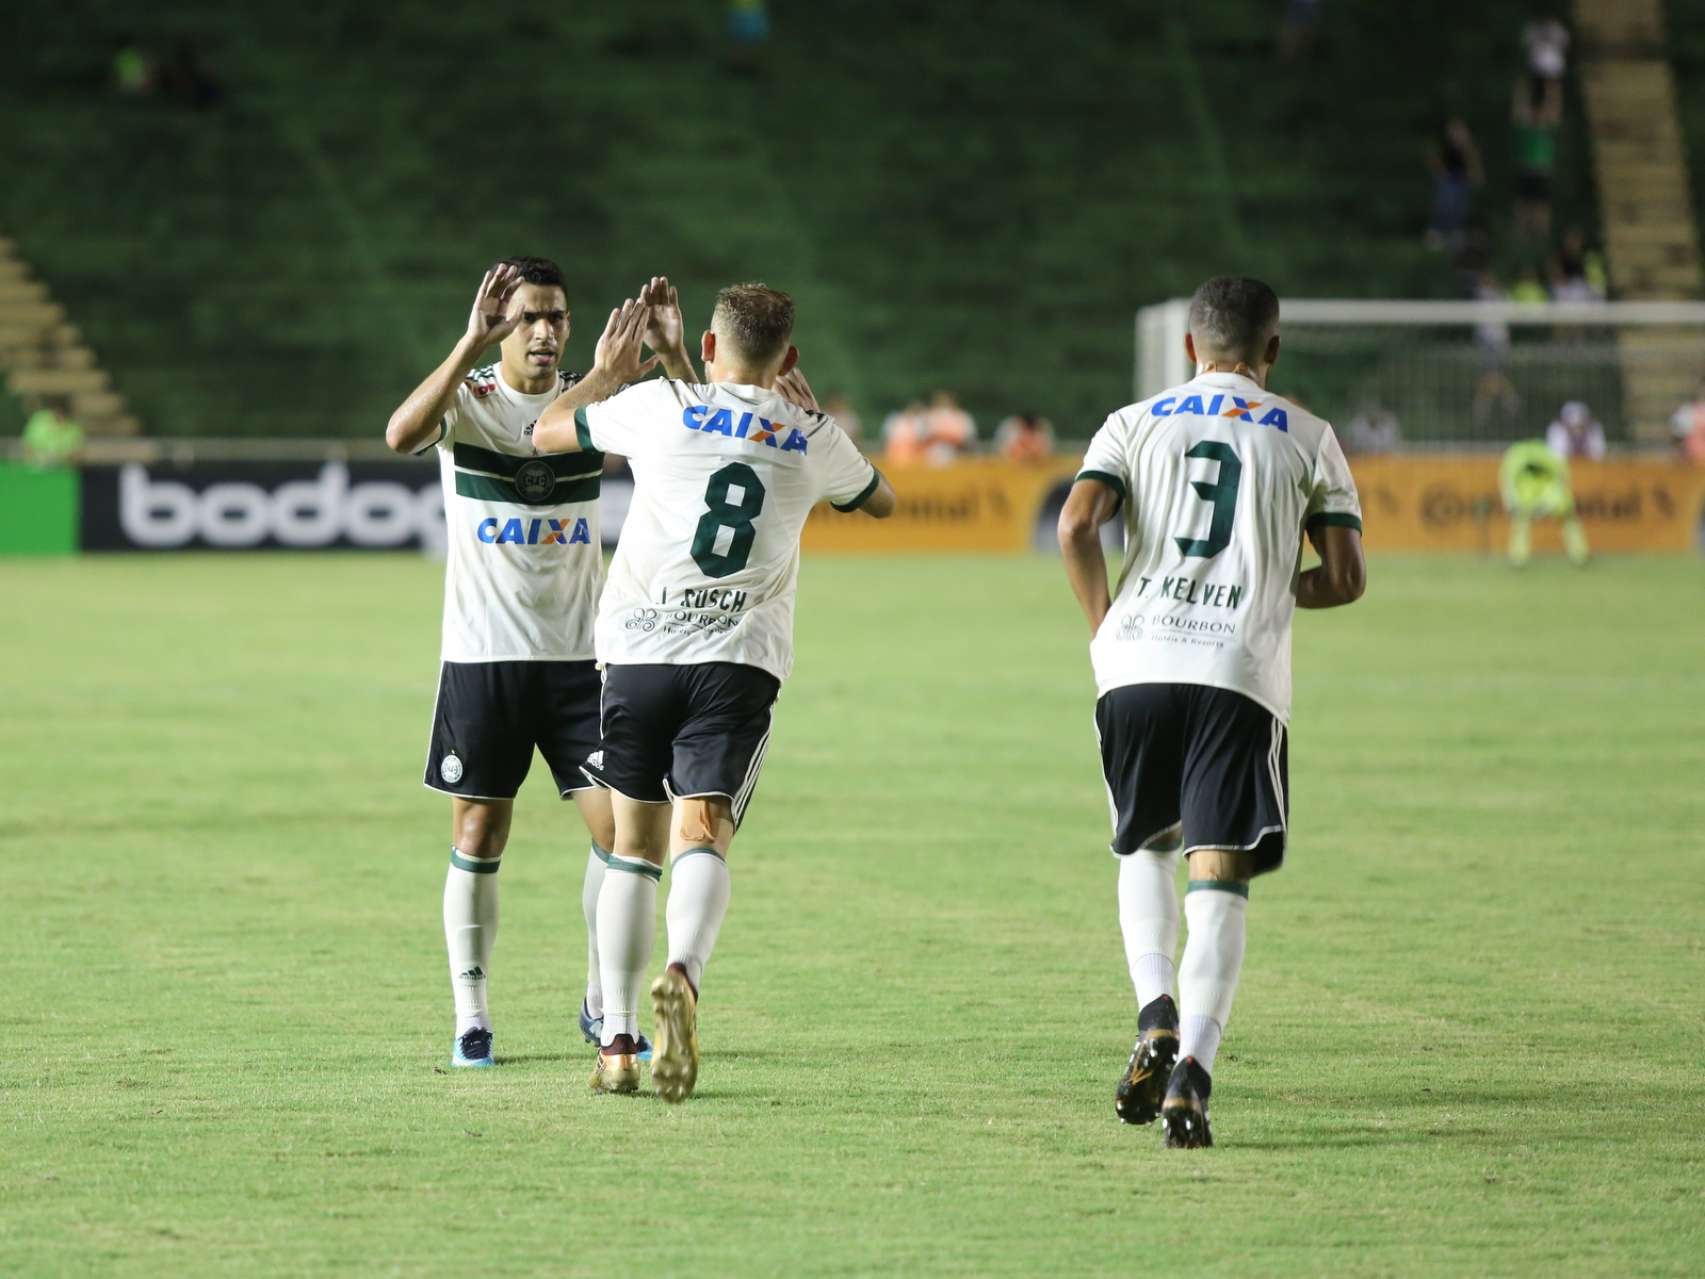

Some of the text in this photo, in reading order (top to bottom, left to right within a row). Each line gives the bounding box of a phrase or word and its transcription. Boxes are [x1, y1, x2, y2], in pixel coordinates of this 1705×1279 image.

[683, 405, 808, 456] CAIXA
[1151, 394, 1289, 433] CAIXA
[1174, 440, 1242, 559] 3
[477, 517, 591, 545] CAIXA
[690, 462, 766, 579] 8
[1161, 576, 1242, 610] KELVEN
[1151, 614, 1236, 635] BOURBON
